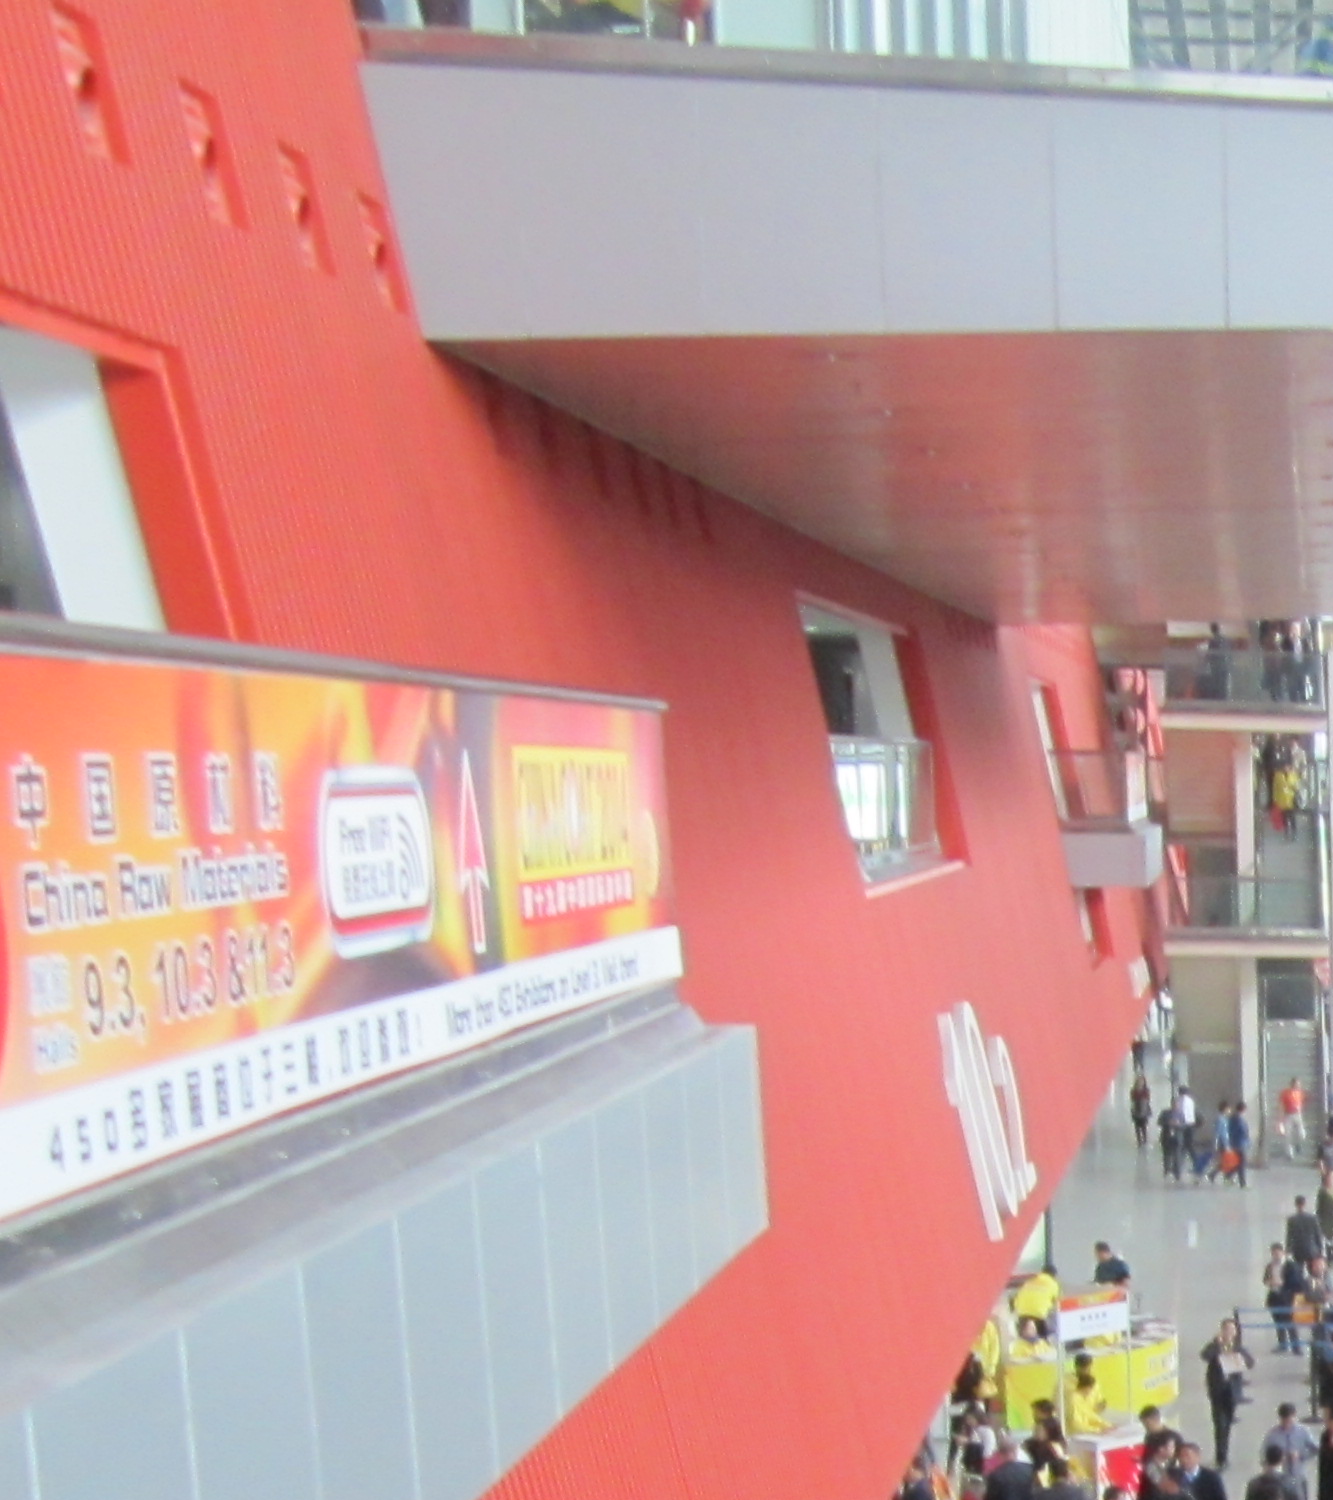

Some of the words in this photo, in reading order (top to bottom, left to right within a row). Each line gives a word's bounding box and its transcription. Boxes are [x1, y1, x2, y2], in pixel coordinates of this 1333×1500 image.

[23, 863, 108, 929] China
[117, 857, 172, 914] Raw
[180, 850, 289, 907] Materials
[84, 955, 147, 1038] 9.3,
[154, 940, 217, 1017] 10.3
